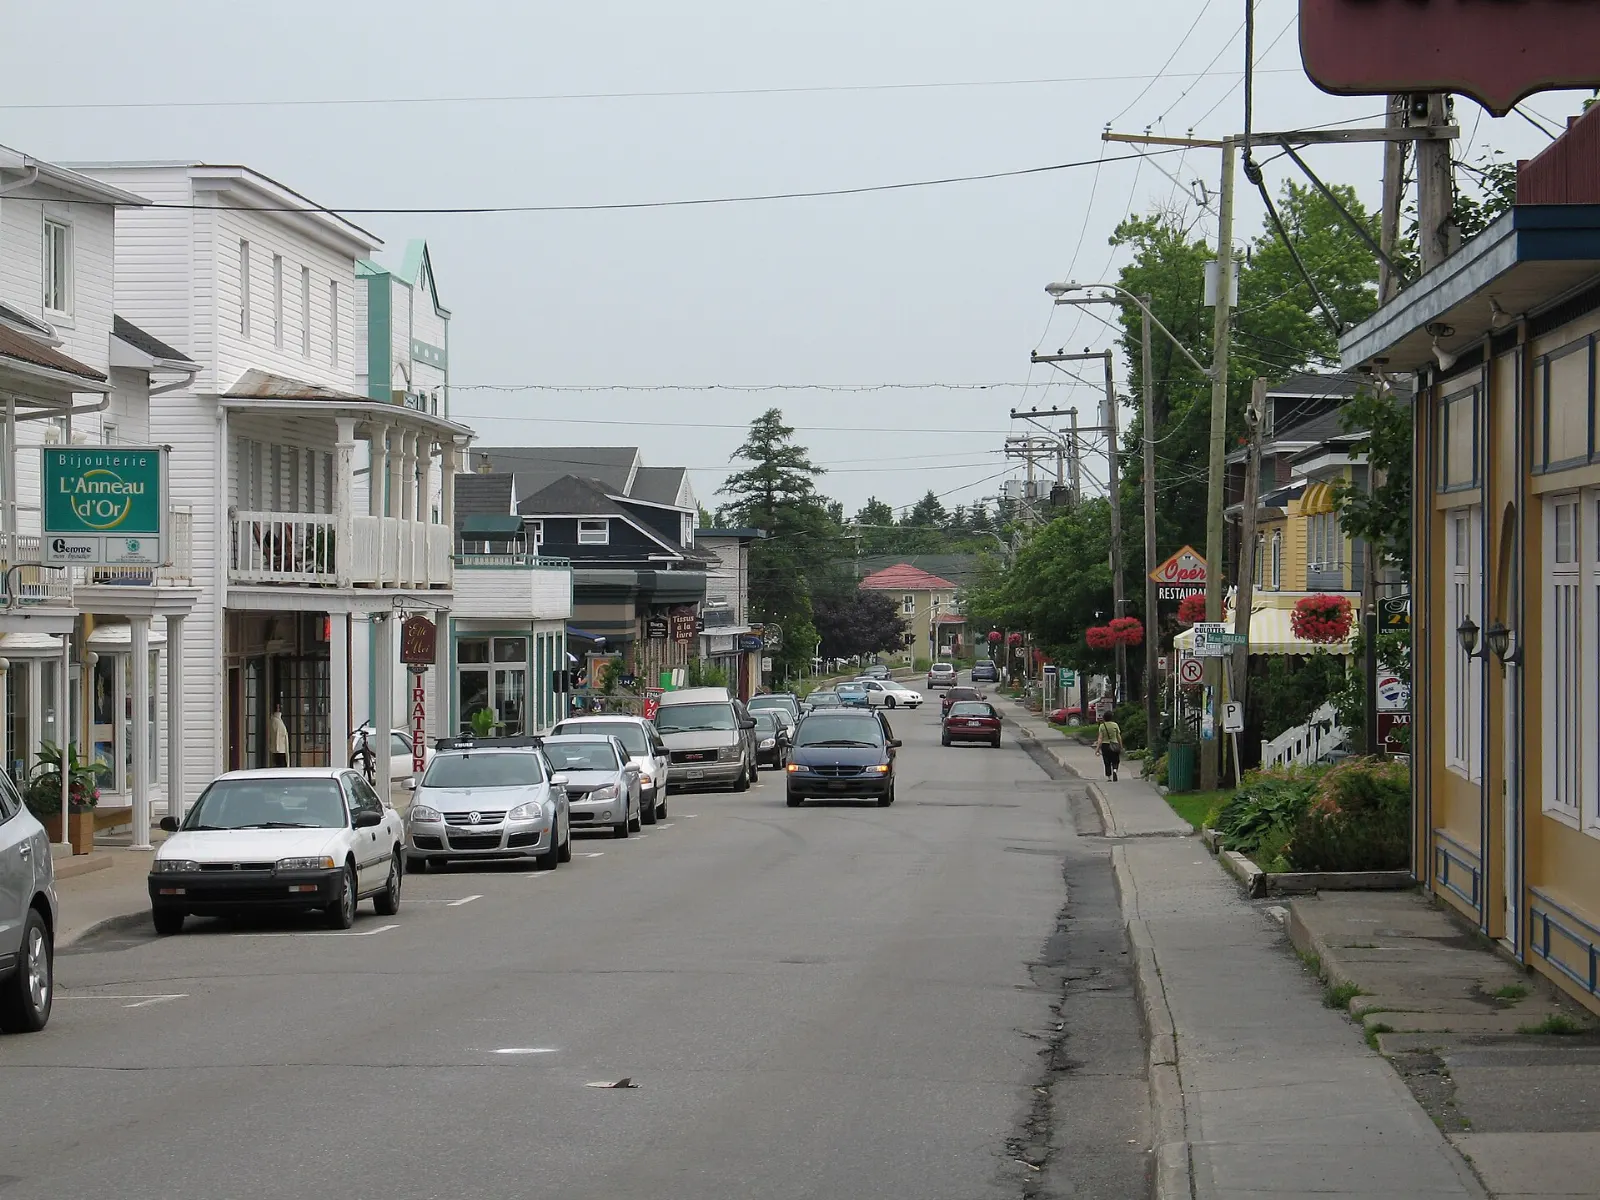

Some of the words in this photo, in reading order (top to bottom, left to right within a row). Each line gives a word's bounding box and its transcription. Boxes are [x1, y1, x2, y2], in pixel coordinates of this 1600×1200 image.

[59, 454, 147, 469] Bijouterie
[60, 477, 144, 494] L'Anneau
[78, 499, 121, 518] d'Or
[1165, 559, 1207, 584] Opér
[1159, 587, 1207, 600] RESTAURA
[672, 615, 695, 623] Tissus
[684, 622, 691, 630] la
[676, 631, 693, 639] livre
[1226, 705, 1236, 718] P
